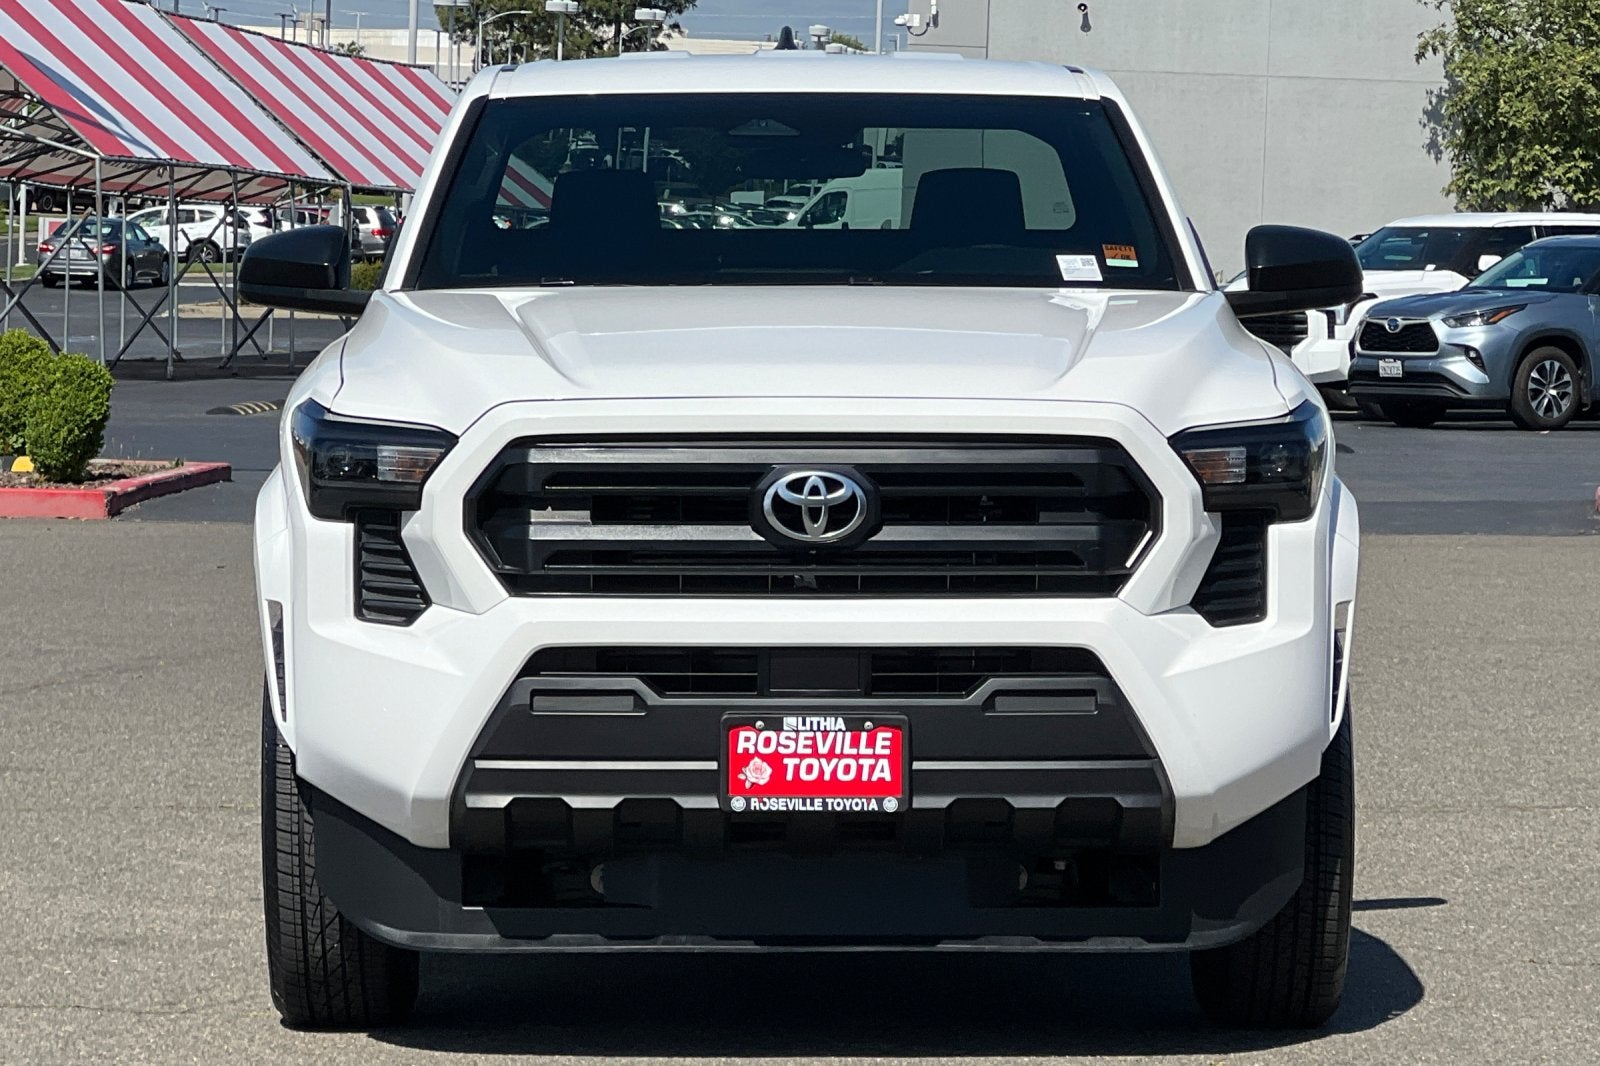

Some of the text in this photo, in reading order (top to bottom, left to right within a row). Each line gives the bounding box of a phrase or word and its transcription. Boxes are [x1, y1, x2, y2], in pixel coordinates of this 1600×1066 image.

[798, 716, 847, 731] LITHIA
[736, 731, 893, 755] ROSEVILLE
[783, 758, 892, 782] TOYOTA
[750, 798, 879, 811] ROSEVILLE TOYOTA
